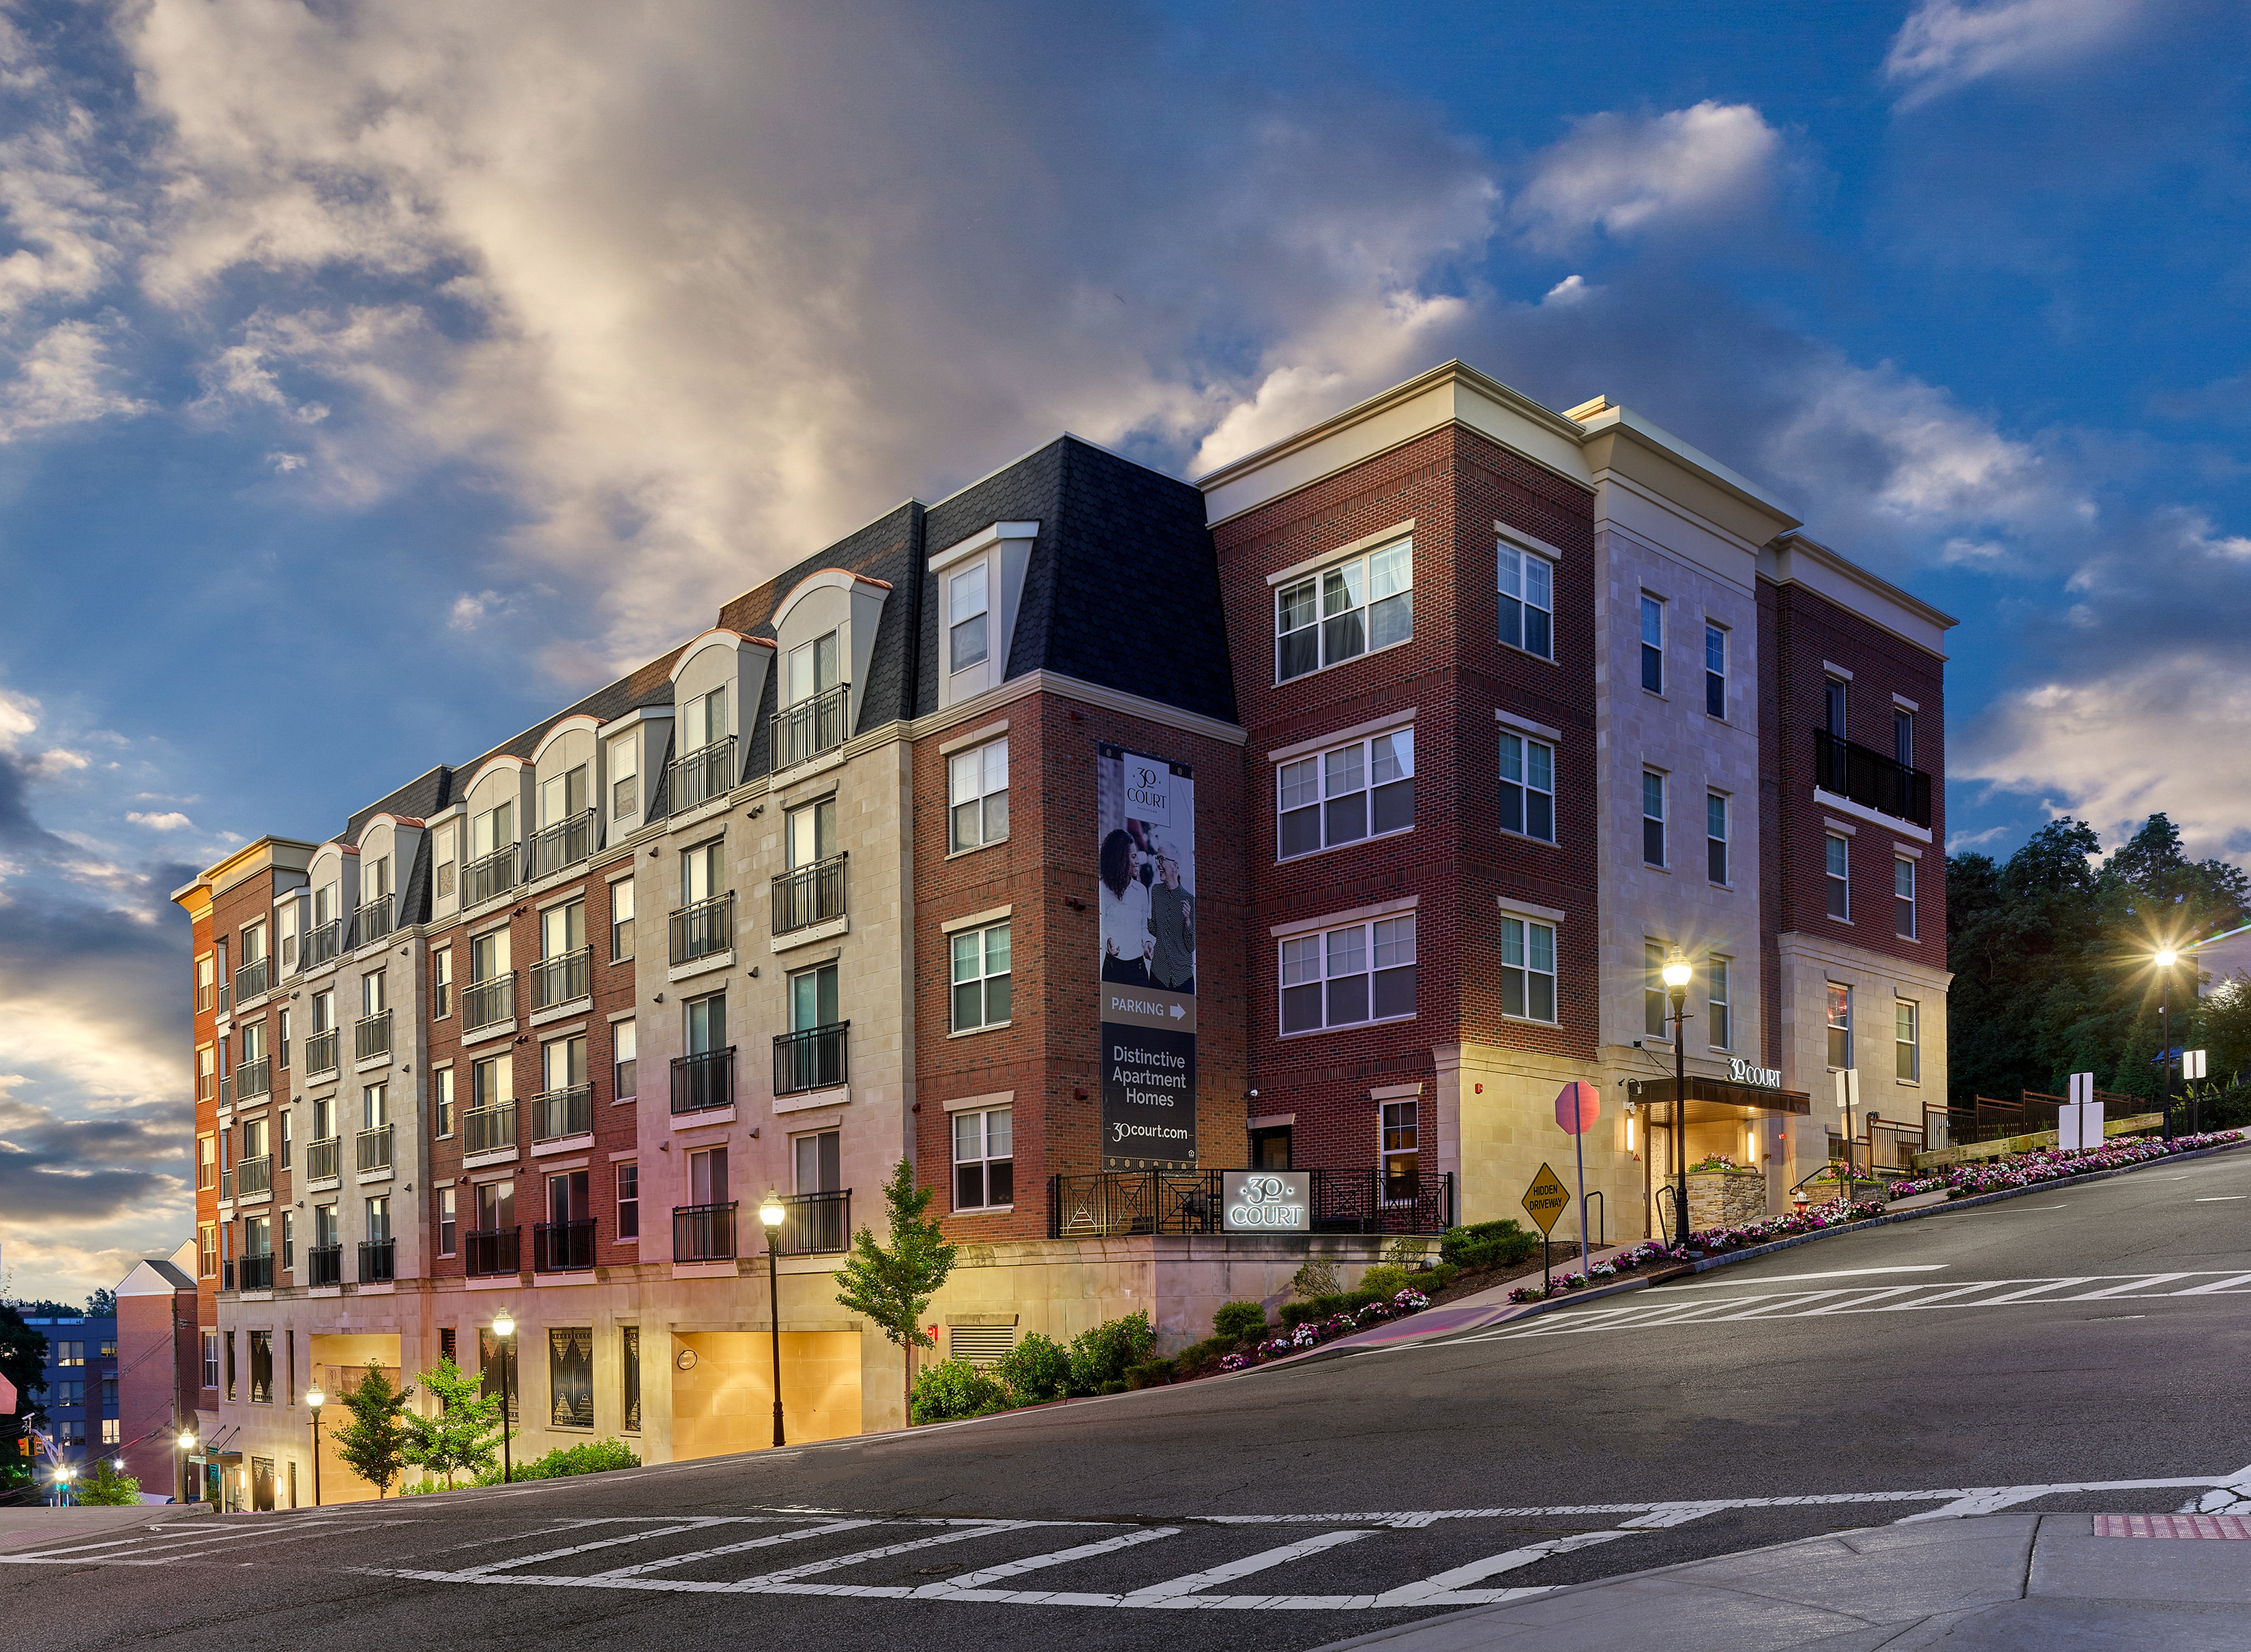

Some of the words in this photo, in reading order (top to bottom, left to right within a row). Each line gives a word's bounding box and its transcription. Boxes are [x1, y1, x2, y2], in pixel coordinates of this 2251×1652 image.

[1136, 767, 1156, 788] 30
[1127, 787, 1167, 809] COURT
[1112, 997, 1164, 1016] PARKING
[1114, 1045, 1186, 1069] Distinctive
[1112, 1065, 1186, 1089] Apartment
[1730, 1058, 1746, 1081] 30
[1746, 1066, 1781, 1088] COURT
[1126, 1087, 1174, 1107] Homes
[1112, 1122, 1188, 1142] 30court.com
[1248, 1177, 1284, 1205] 30
[1533, 1183, 1558, 1196] HIDDEN
[1529, 1197, 1562, 1210] DRIVEWAY
[1231, 1206, 1303, 1225] COURT
